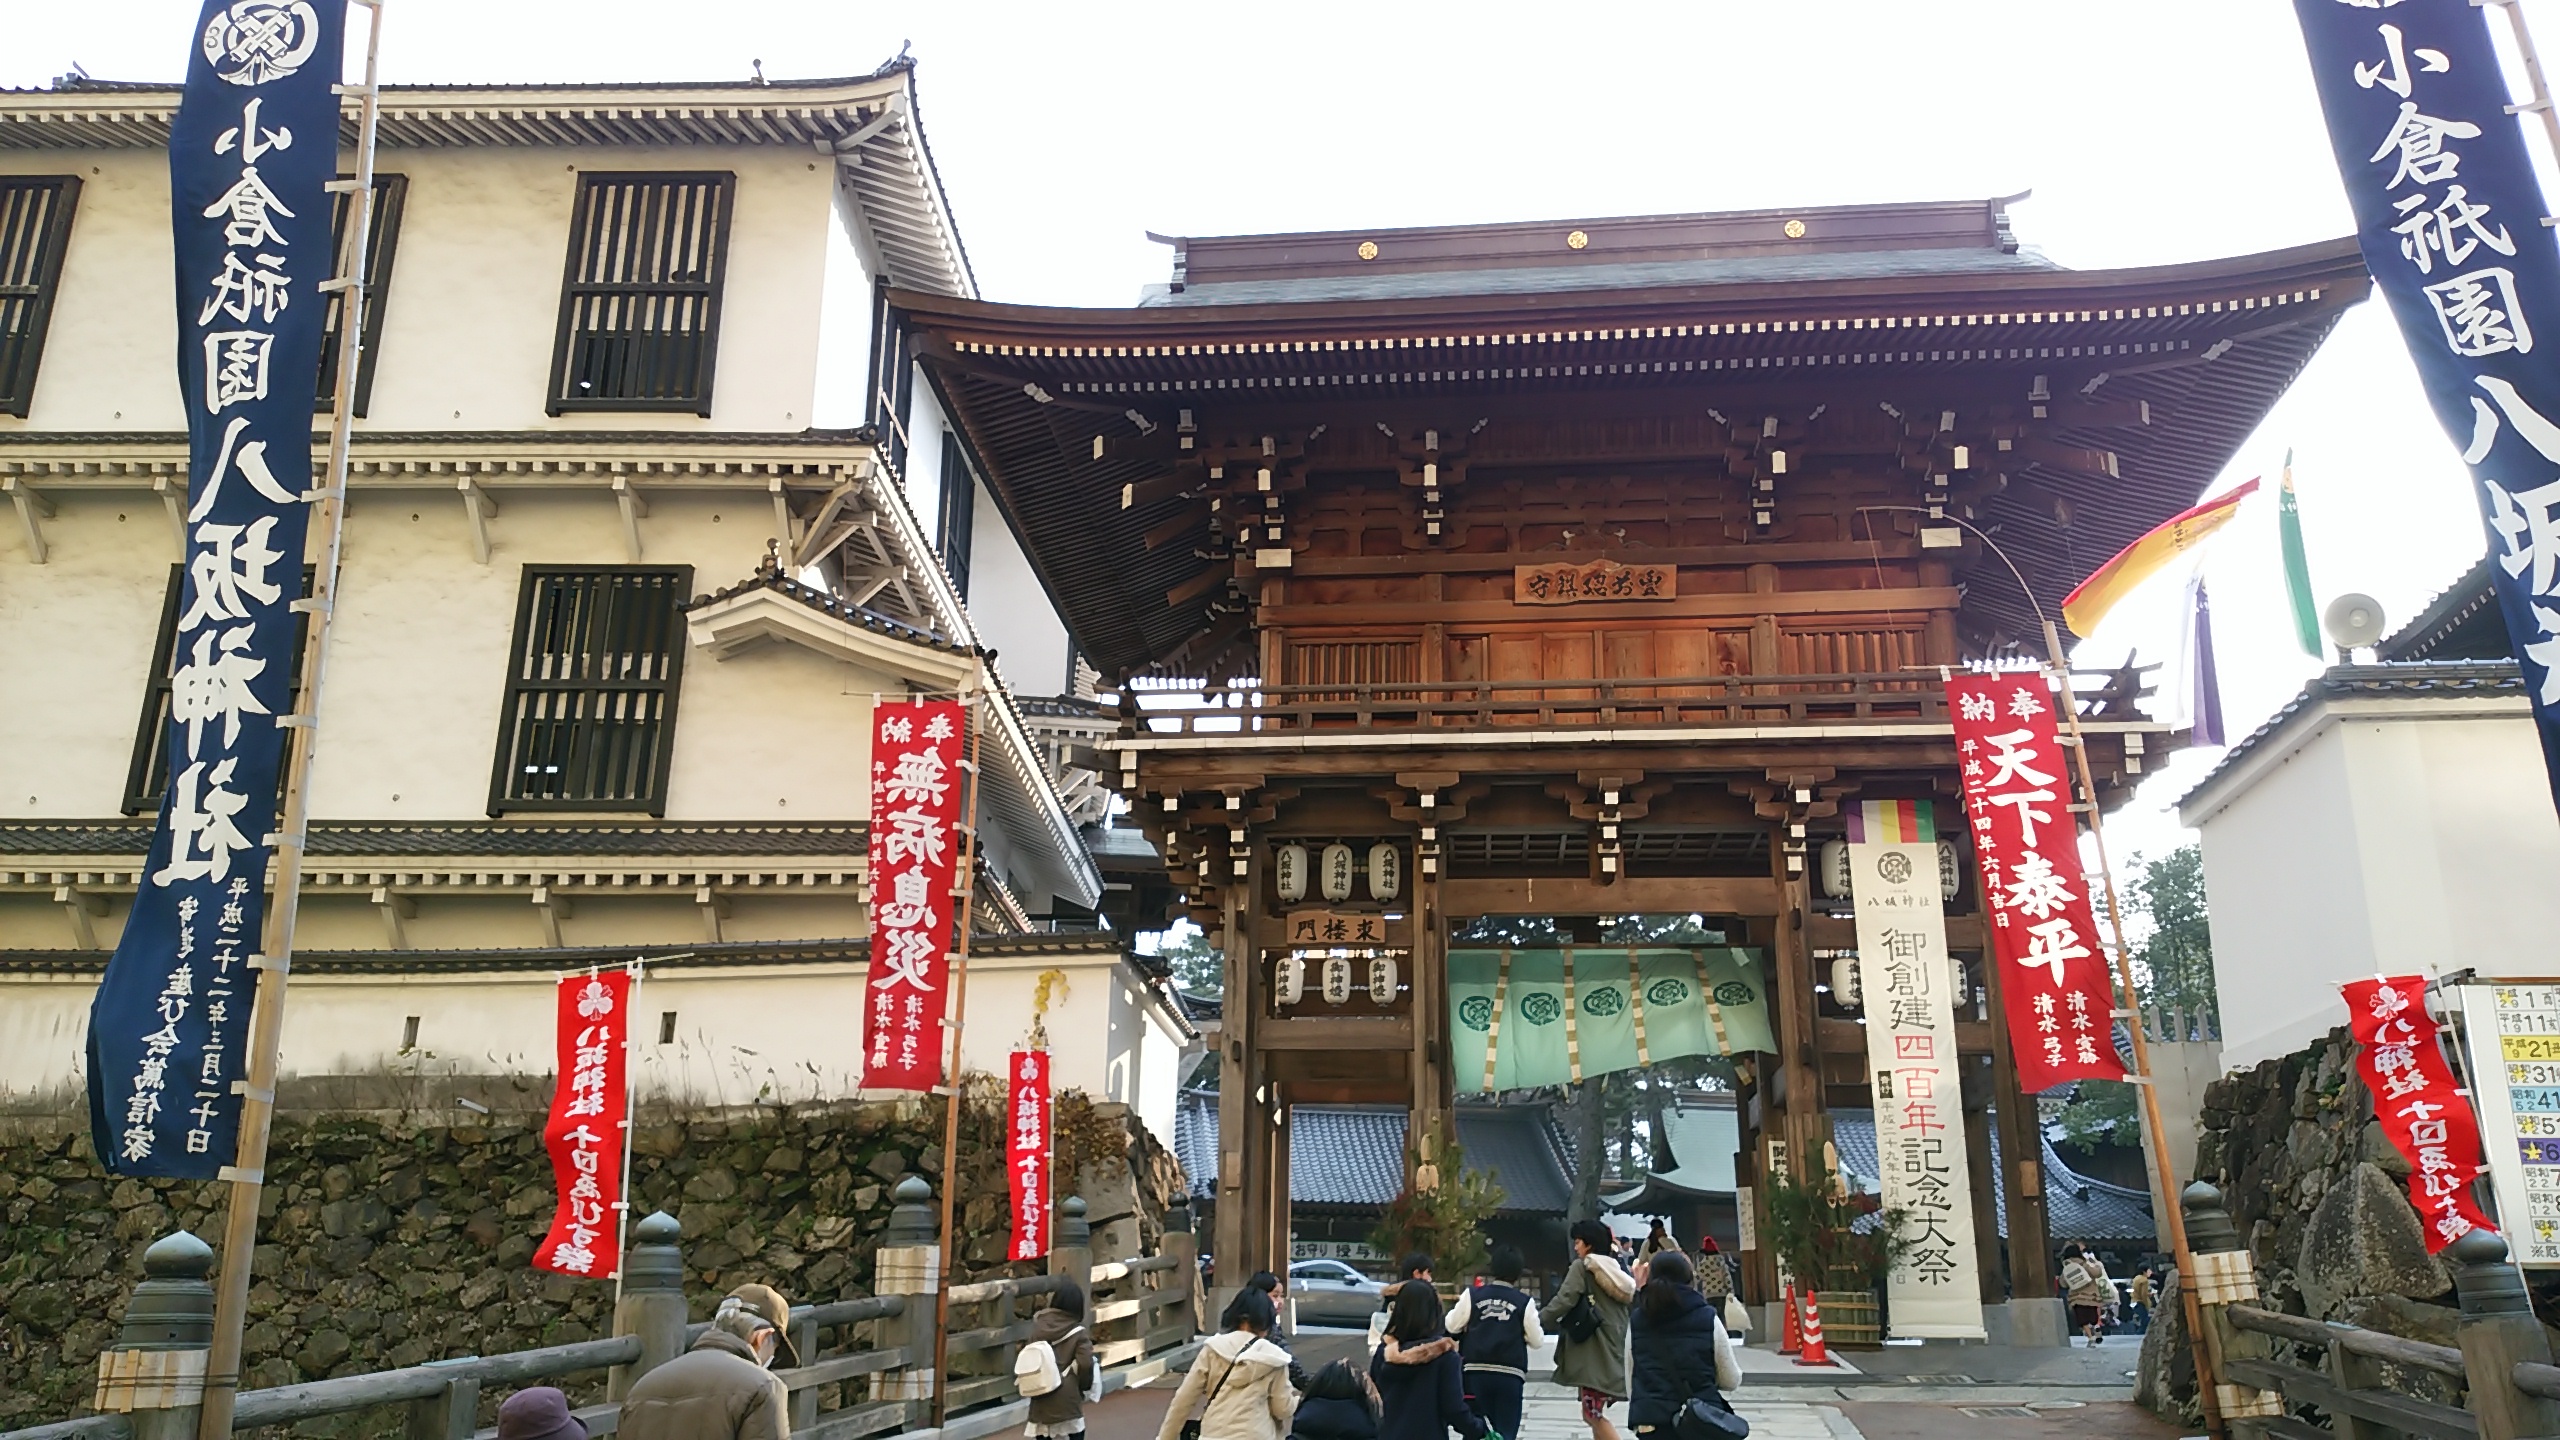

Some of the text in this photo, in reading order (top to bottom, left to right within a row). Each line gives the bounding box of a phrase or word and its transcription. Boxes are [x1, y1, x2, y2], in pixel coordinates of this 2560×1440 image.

[1960, 688, 2046, 723] 奉納
[1984, 728, 2091, 988] 天下泰平
[1281, 850, 1293, 890] 八坂神社
[1333, 850, 1347, 891] 八坂神社
[1382, 849, 1395, 889] 八坂神社
[1294, 918, 1381, 941] 東楼門
[2525, 990, 2535, 1008] 1
[2499, 1013, 2523, 1023] 平成
[2524, 1014, 2547, 1032] 11
[2503, 1038, 2527, 1048] 平成
[2528, 1040, 2551, 1058] 21
[2533, 1065, 2556, 1083] 31
[2512, 1090, 2536, 1099] 昭和
[1881, 927, 1957, 1286] 御創建四百年記念大祭
[2515, 1101, 2535, 1110] 52
[2525, 1168, 2549, 1177] 昭和
[2529, 1179, 2549, 1188] 22
[2530, 1193, 2553, 1203] 昭和
[2531, 1205, 2550, 1215] 12
